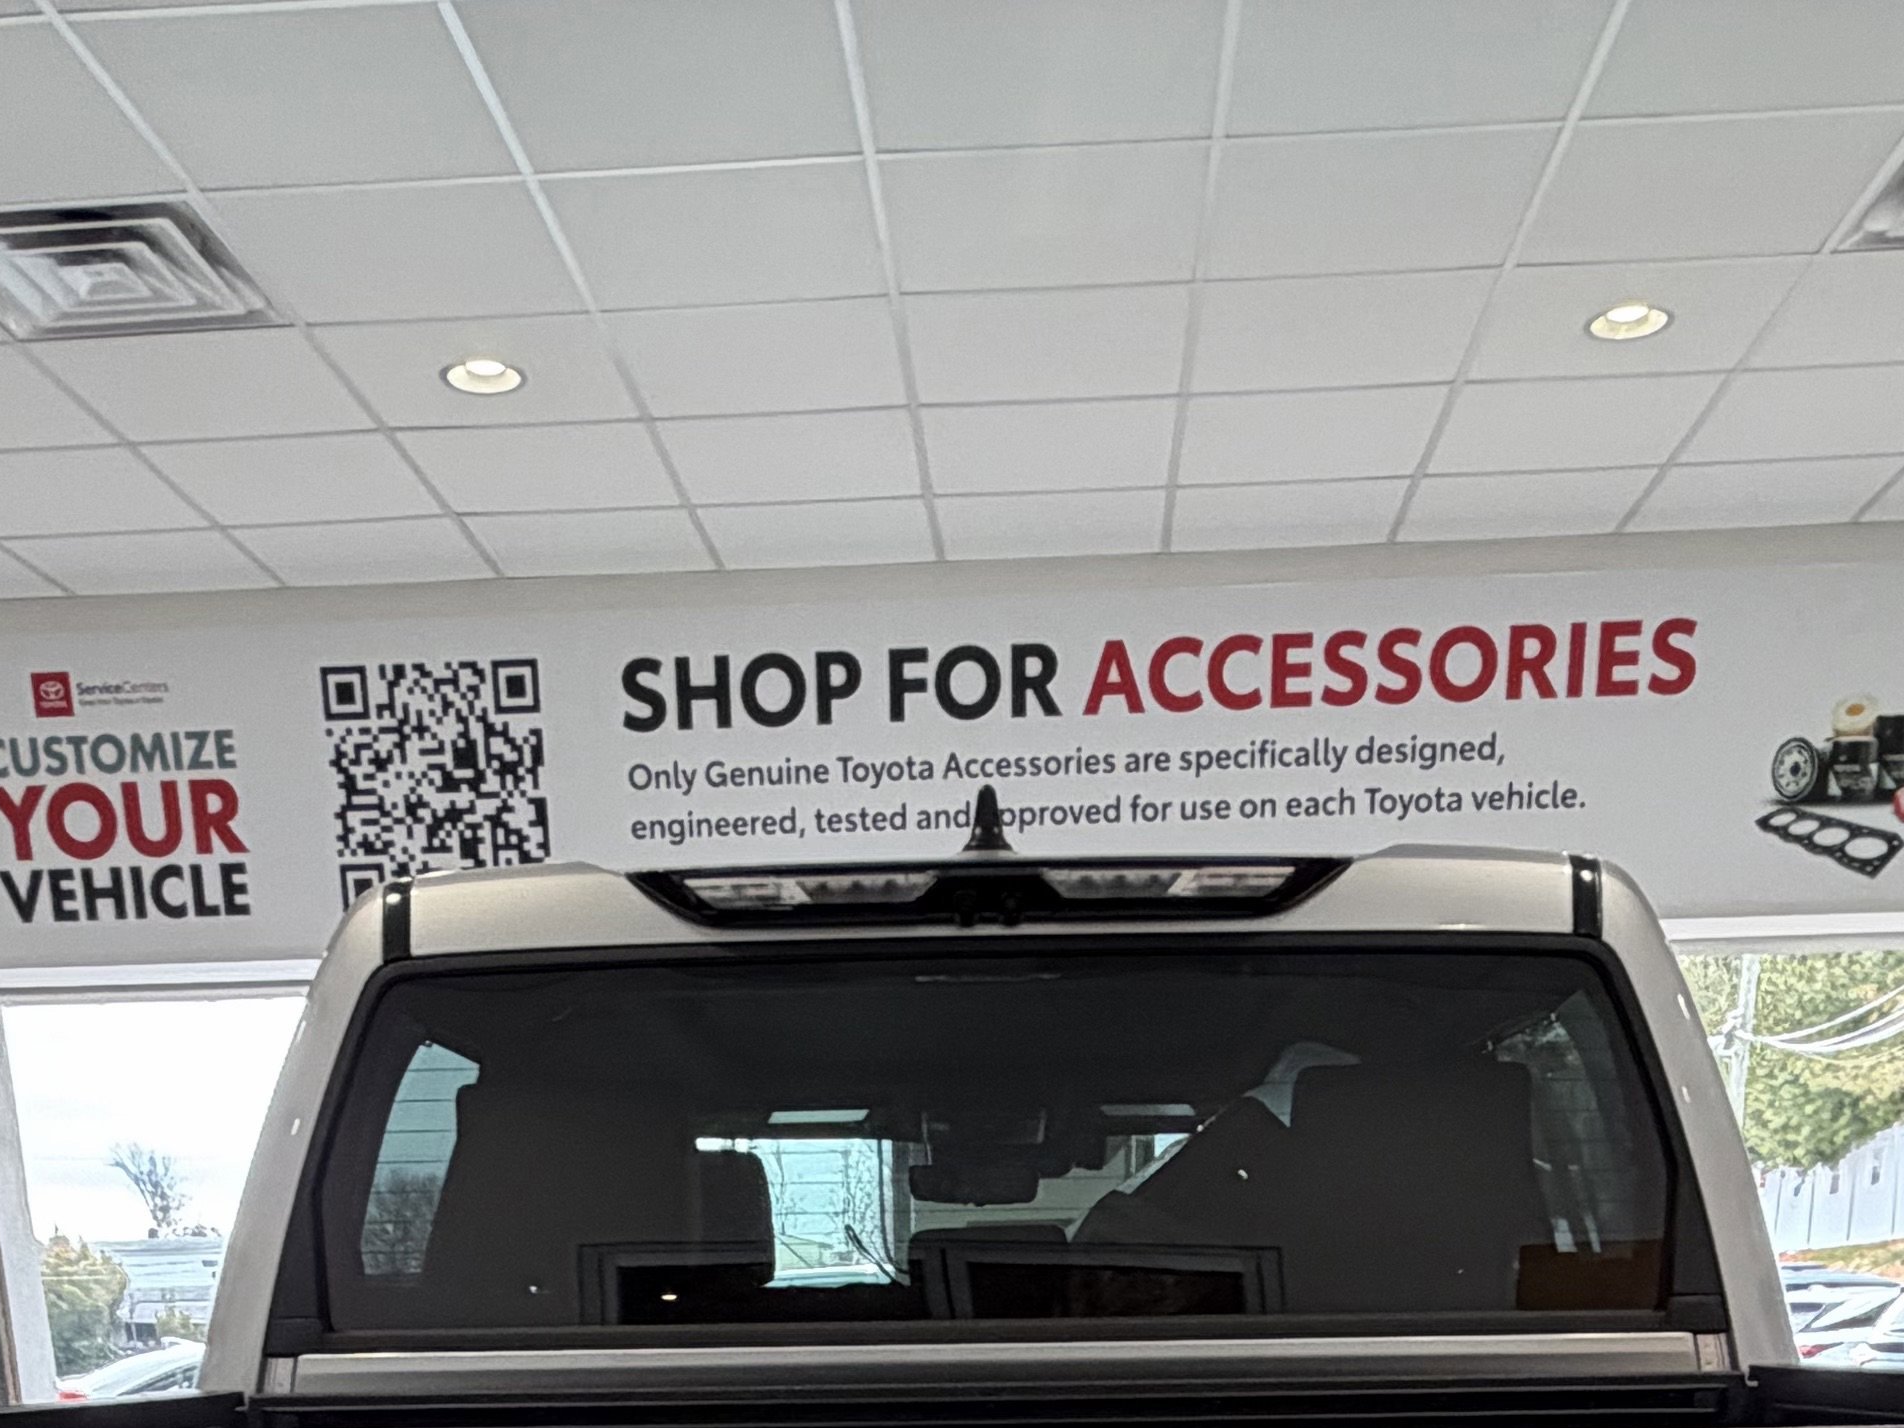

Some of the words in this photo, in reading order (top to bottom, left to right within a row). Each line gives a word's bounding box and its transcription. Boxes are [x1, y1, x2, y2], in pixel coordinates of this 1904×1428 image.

[621, 650, 862, 732] SHOP
[888, 643, 1062, 722] FOR
[1083, 617, 1698, 716] ACCESSORIES
[628, 762, 696, 794] Only
[704, 758, 831, 789] Genuine
[837, 752, 936, 790] Toyota
[942, 746, 1116, 781] Accessories
[1124, 748, 1171, 774] are
[1178, 734, 1349, 779] specifically
[1355, 732, 1506, 770] designed,
[631, 806, 807, 846] engineered,
[815, 802, 908, 835] tested
[916, 801, 970, 831] and
[999, 794, 1121, 834] pproved
[1128, 790, 1172, 824] for
[1179, 792, 1231, 821] use
[1239, 793, 1277, 819] on
[1284, 783, 1356, 819] each
[1365, 783, 1464, 823] Toyota
[1471, 777, 1587, 813] vehicle.
